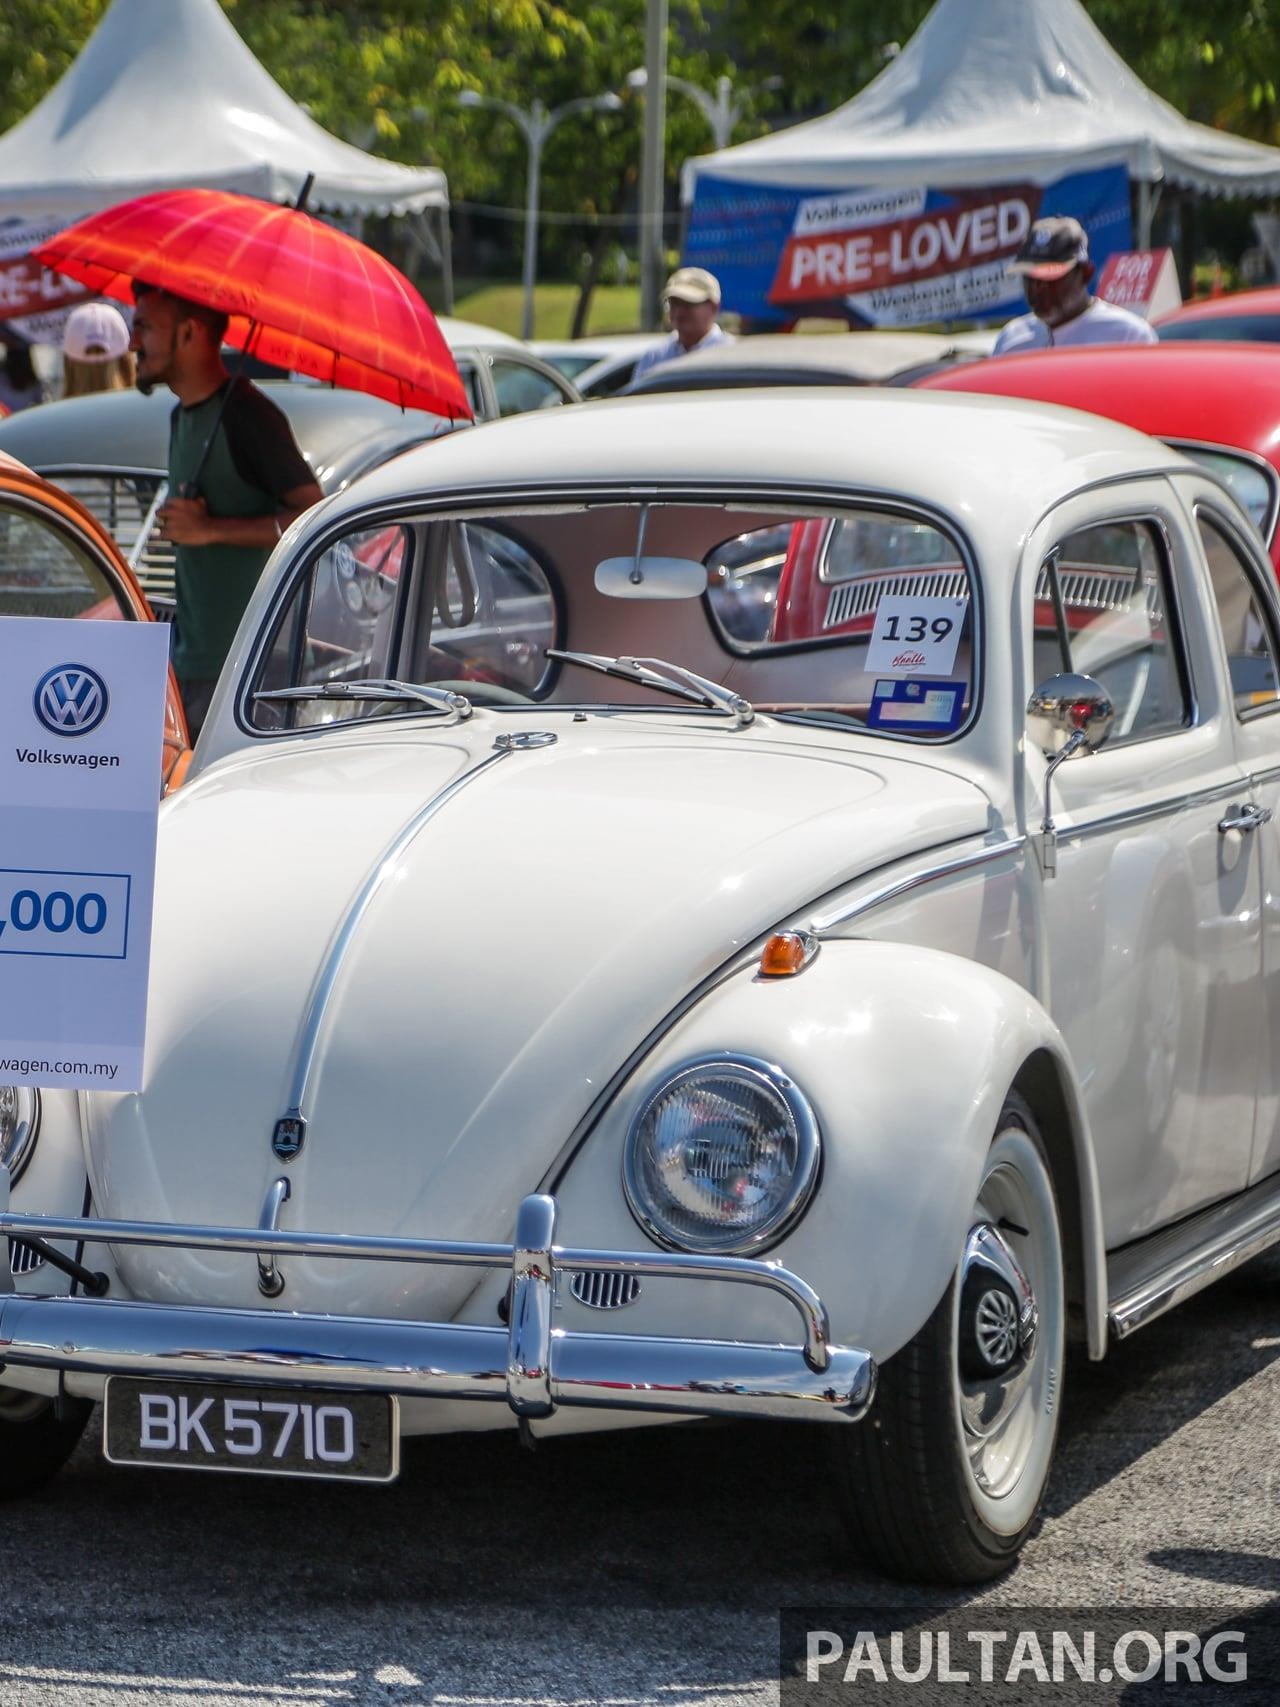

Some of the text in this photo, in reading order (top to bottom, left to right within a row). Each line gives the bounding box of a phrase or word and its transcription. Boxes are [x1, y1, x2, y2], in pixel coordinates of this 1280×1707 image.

[790, 199, 1030, 290] PRE-LOVED
[881, 615, 954, 643] 139
[16, 749, 119, 769] Volkswagen
